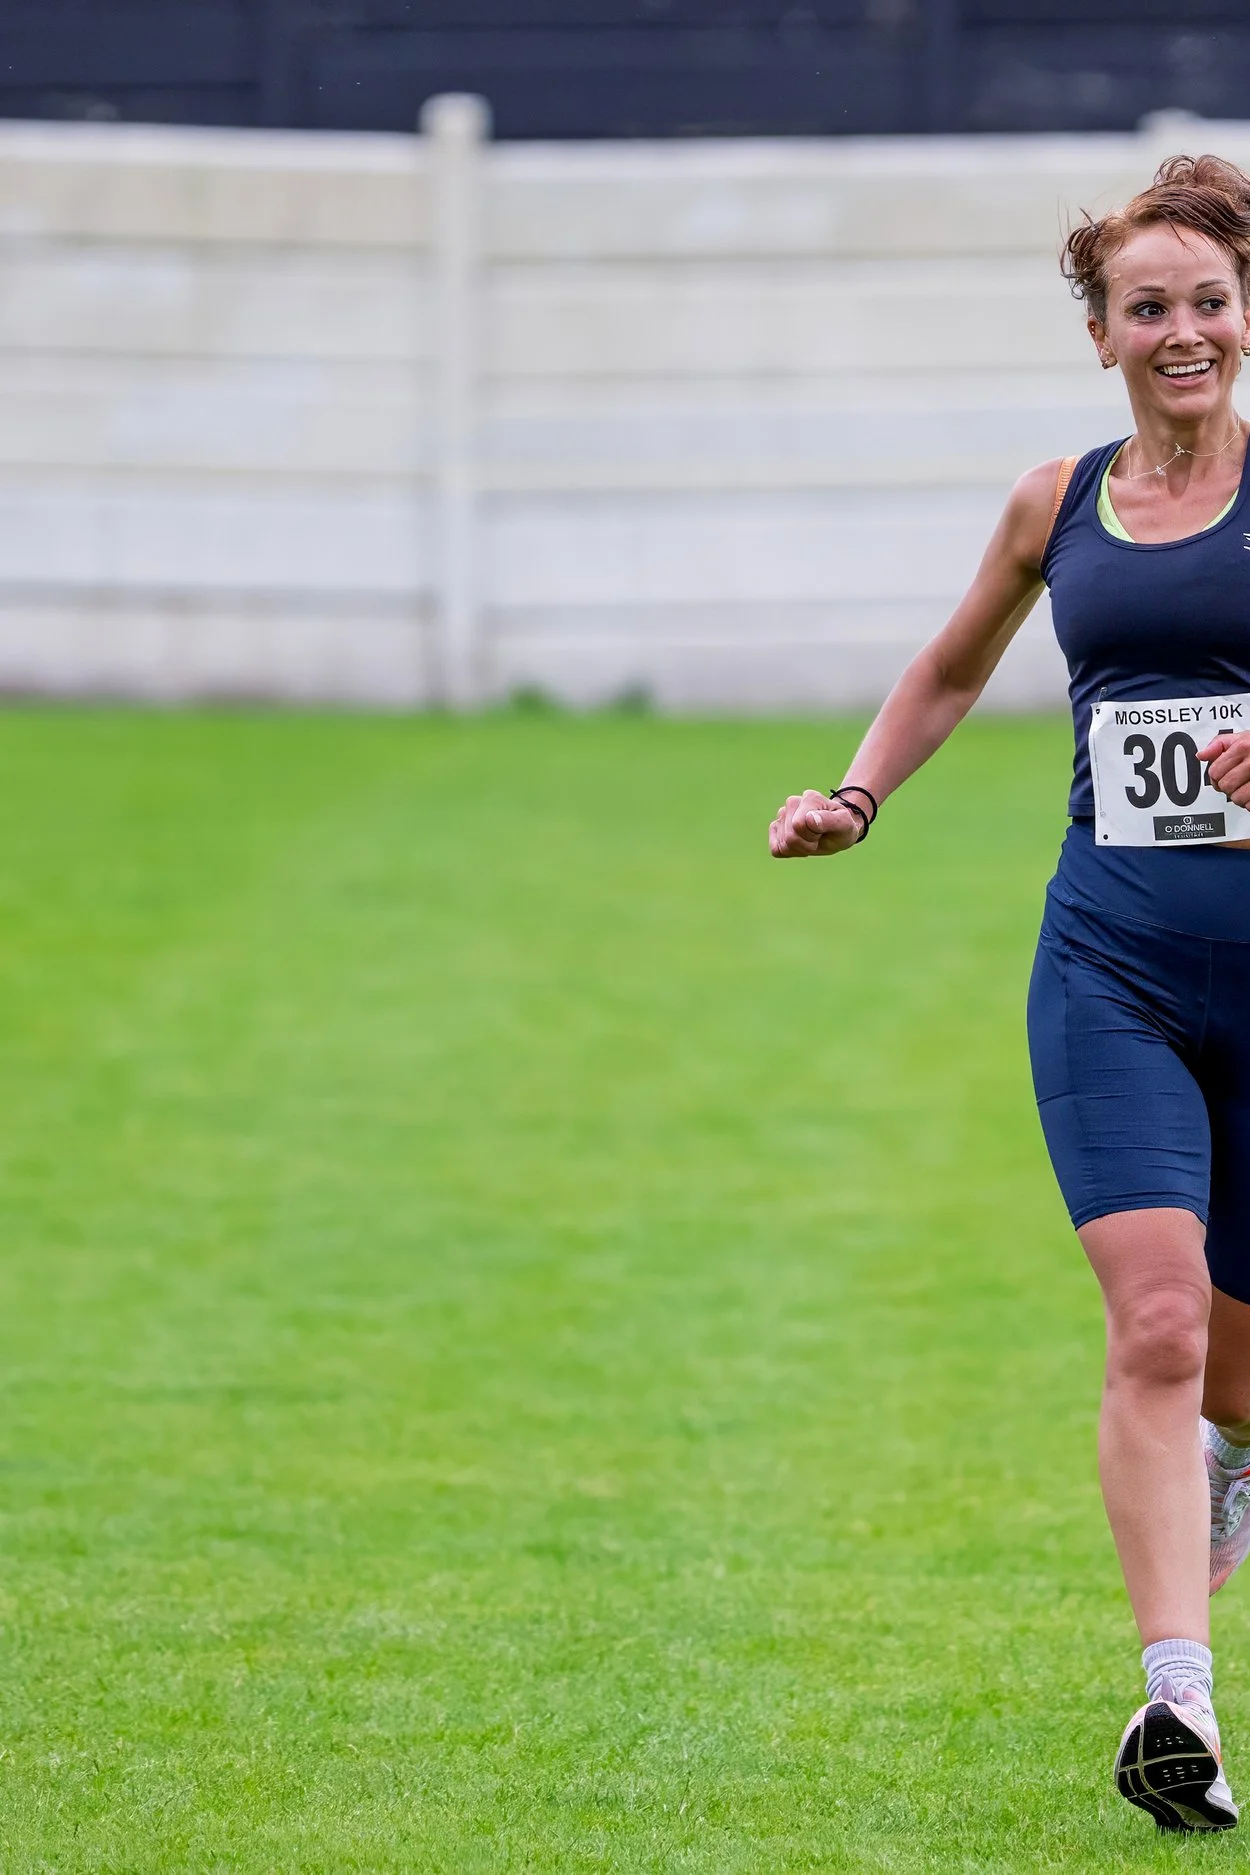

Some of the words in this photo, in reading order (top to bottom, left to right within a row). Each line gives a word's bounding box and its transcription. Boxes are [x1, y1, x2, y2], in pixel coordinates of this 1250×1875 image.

[1115, 706, 1203, 725] MOSSLEY
[1208, 703, 1243, 720] 10K
[1123, 729, 1234, 809] 30
